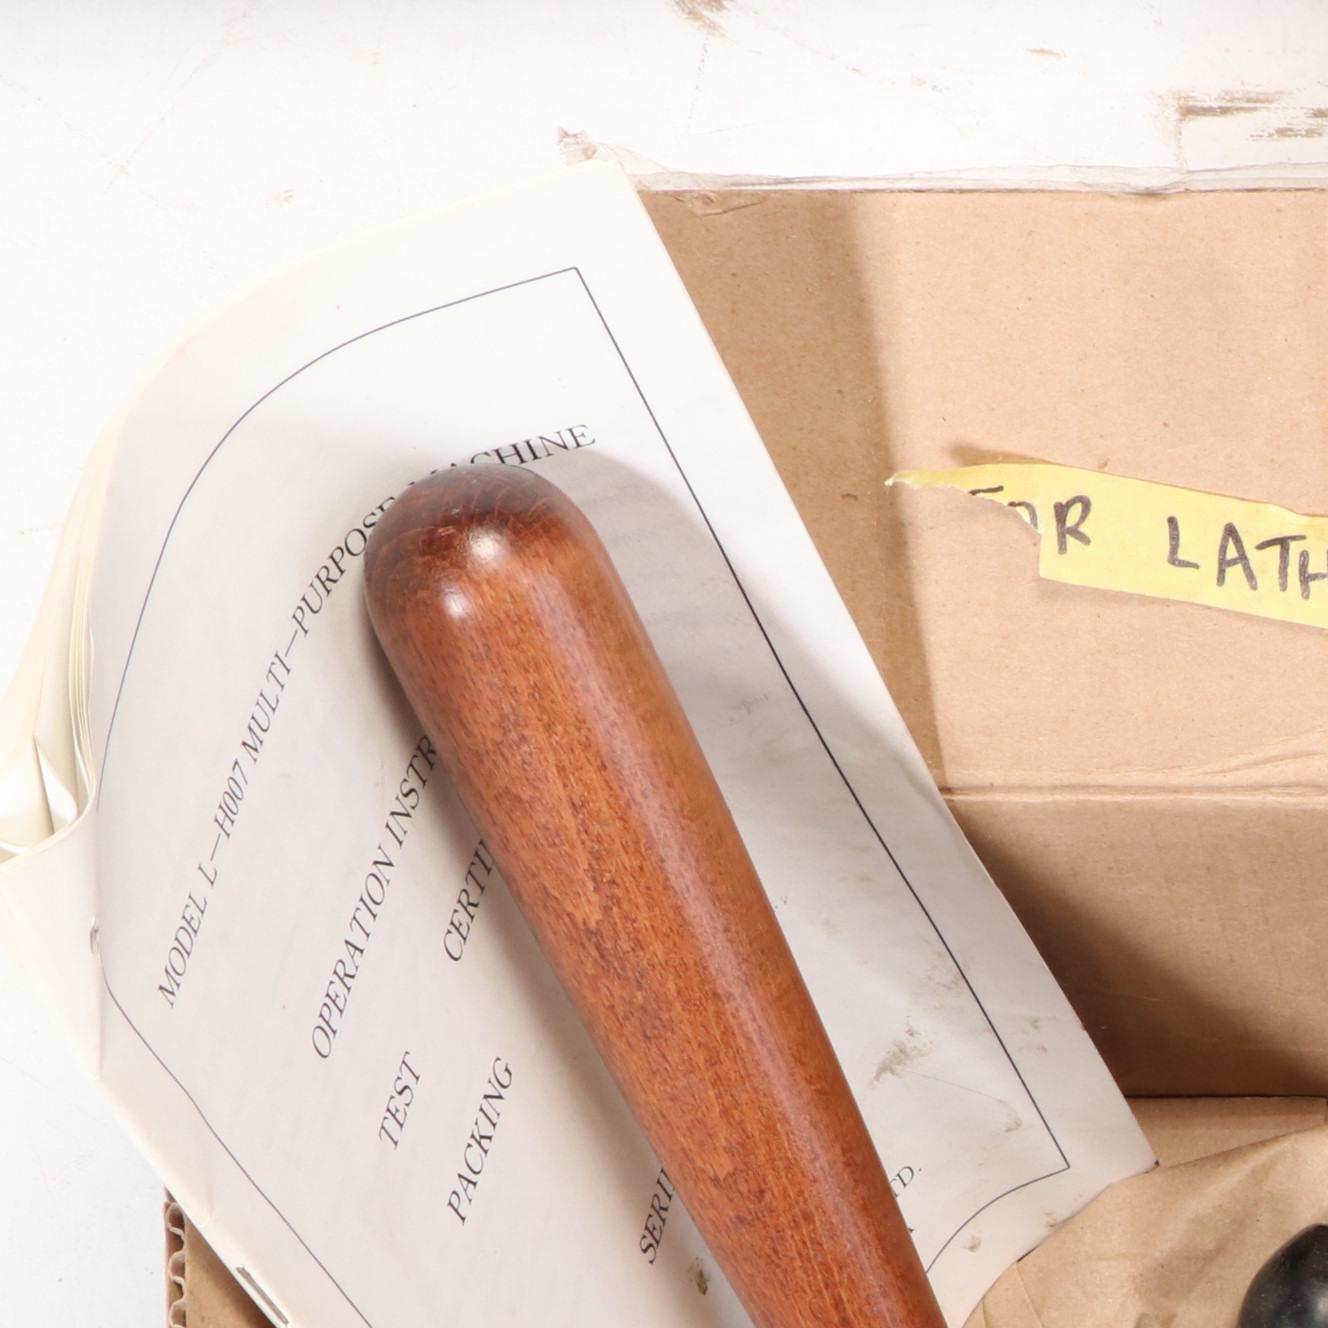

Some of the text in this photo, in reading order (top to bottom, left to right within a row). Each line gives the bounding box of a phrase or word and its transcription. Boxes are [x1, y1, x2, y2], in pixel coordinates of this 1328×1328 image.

[158, 892, 207, 1008] MODEL
[311, 844, 396, 1060] OPERATION
[378, 1050, 422, 1150] TEST
[446, 1056, 514, 1226] PACKING
